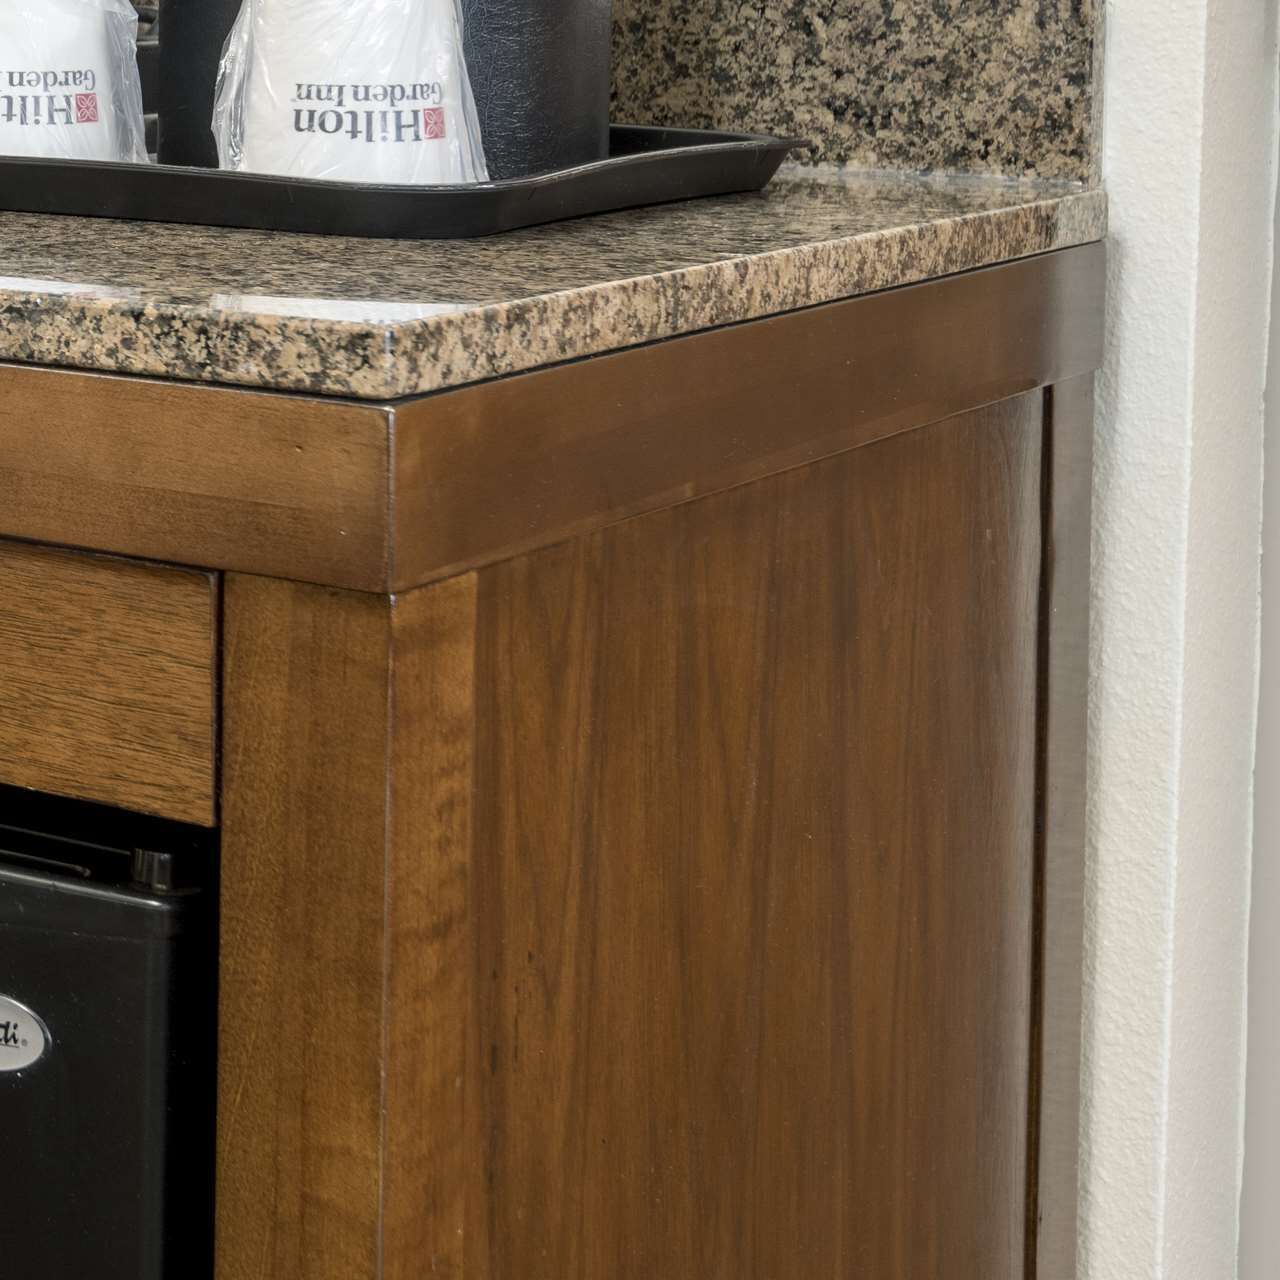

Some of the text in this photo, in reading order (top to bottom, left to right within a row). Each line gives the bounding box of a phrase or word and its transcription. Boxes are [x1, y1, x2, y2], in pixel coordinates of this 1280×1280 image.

[7, 69, 96, 92] Garden
[296, 82, 441, 107] Garden Inn
[293, 108, 423, 142] Hilton
